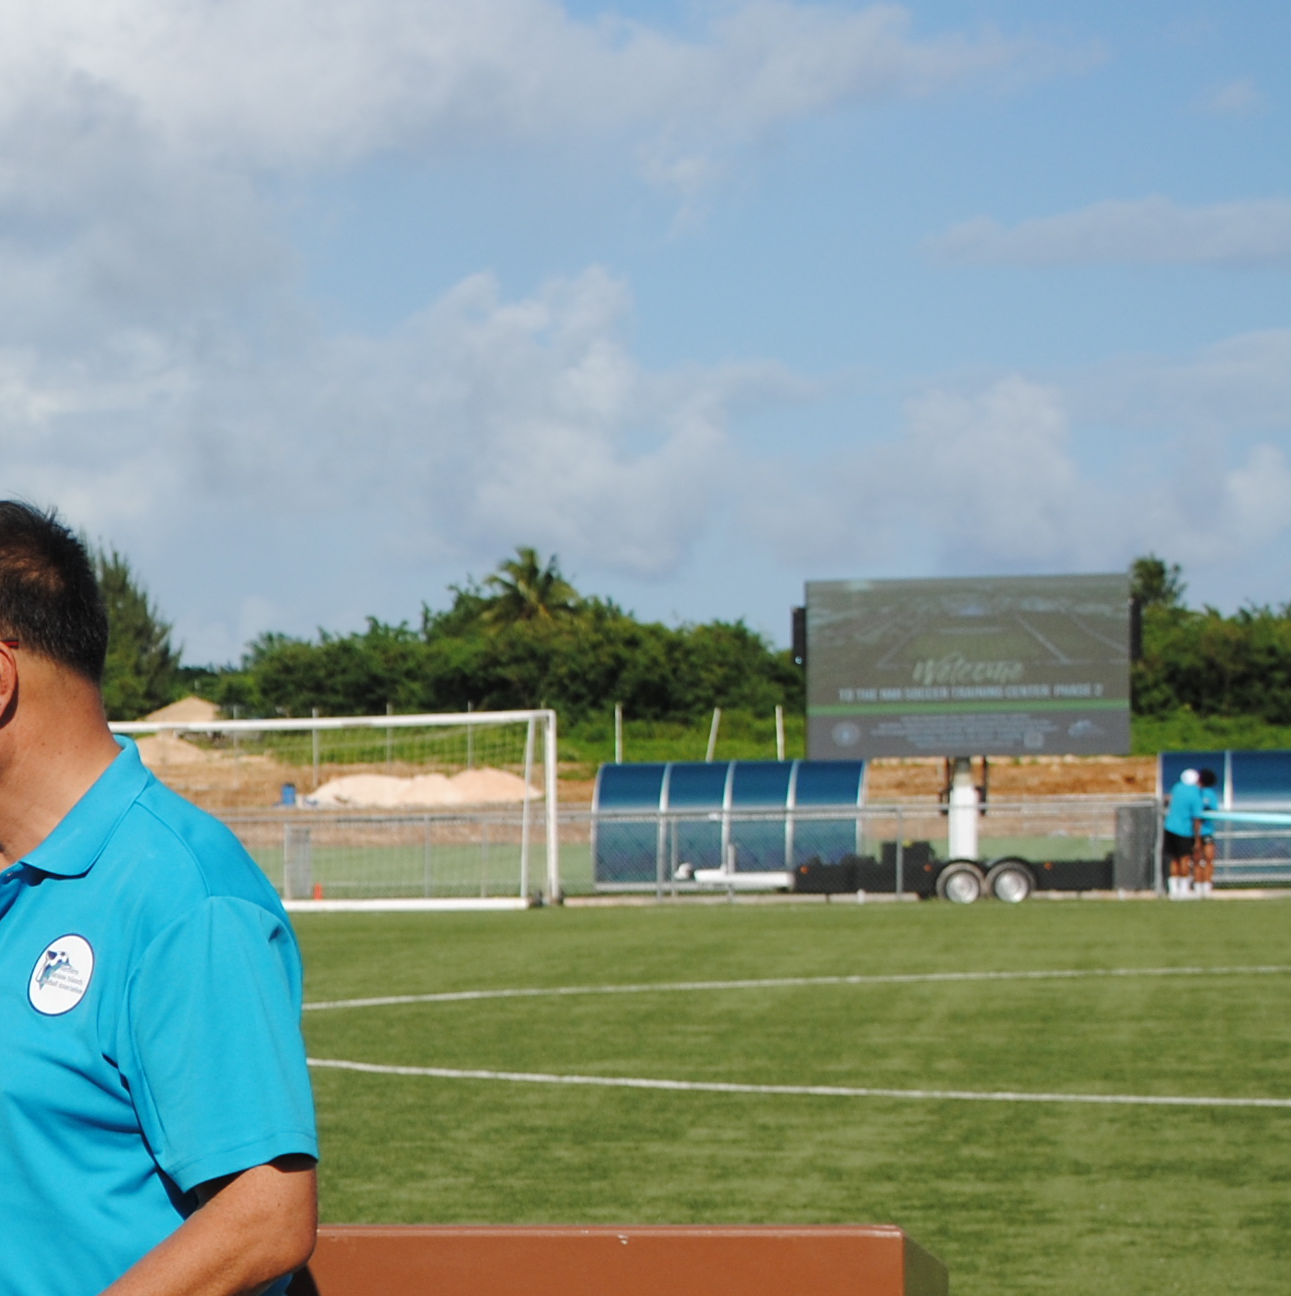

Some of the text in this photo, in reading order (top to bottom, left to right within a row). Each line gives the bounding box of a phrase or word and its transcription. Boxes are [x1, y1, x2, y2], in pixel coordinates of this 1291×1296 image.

[912, 653, 1024, 685] Welcome
[856, 687, 878, 700] THE
[904, 686, 949, 700] SOCCER
[951, 685, 1002, 699] TRAINING
[1004, 684, 1050, 698] CENTER
[1053, 683, 1090, 697] PHASE
